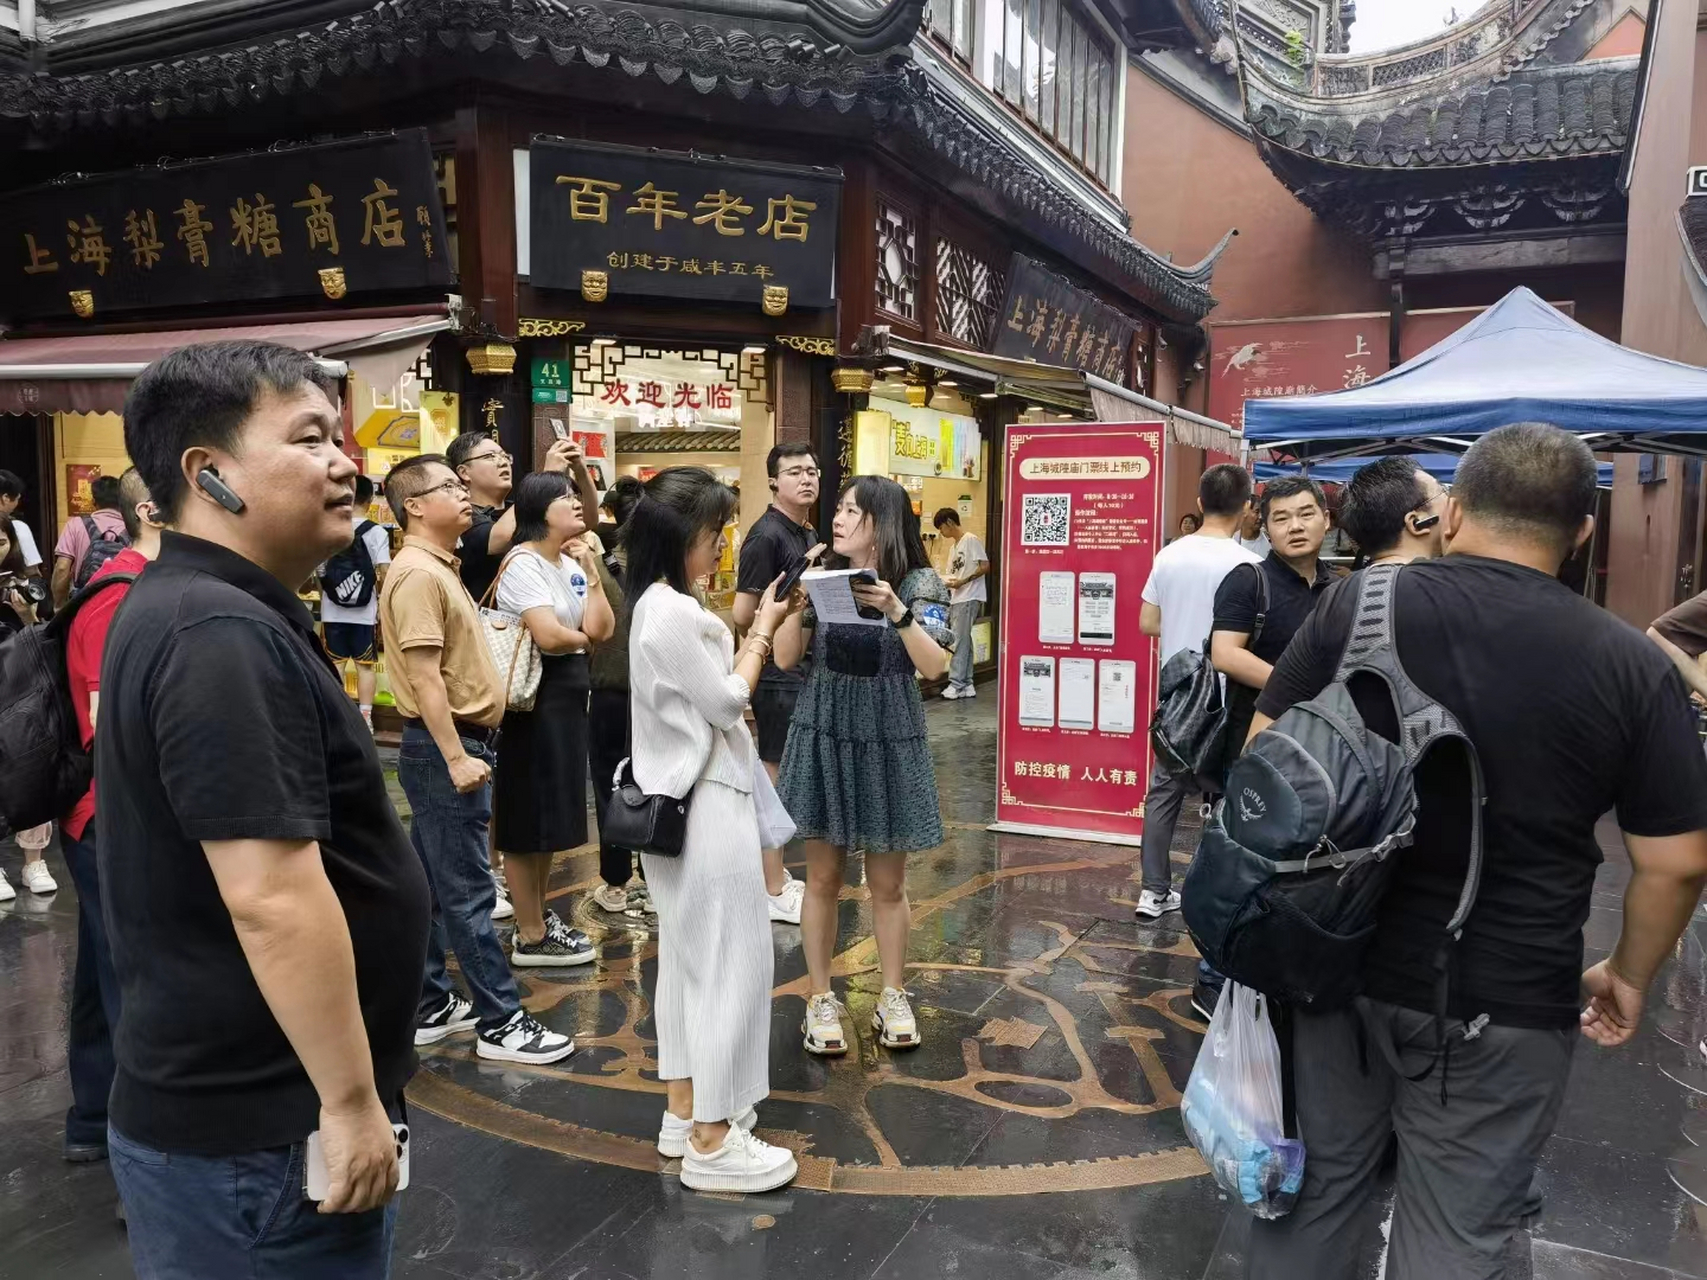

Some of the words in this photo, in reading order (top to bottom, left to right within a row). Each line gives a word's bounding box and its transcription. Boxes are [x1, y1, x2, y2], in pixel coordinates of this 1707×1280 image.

[556, 175, 817, 242] 百年老店
[24, 178, 406, 276] 上海梨膏糖商店
[606, 251, 775, 280] 创建于咸丰五年
[541, 362, 560, 378] 41
[1342, 334, 1371, 389] 上海
[600, 378, 734, 409] 欢迎光临
[1030, 461, 1142, 474] 上海城隍庙门票线上预约
[335, 570, 362, 600] NIKE
[1014, 761, 1071, 780] 防控疫情
[1080, 768, 1138, 786] 人人有责
[1243, 787, 1267, 813] OSPREY
